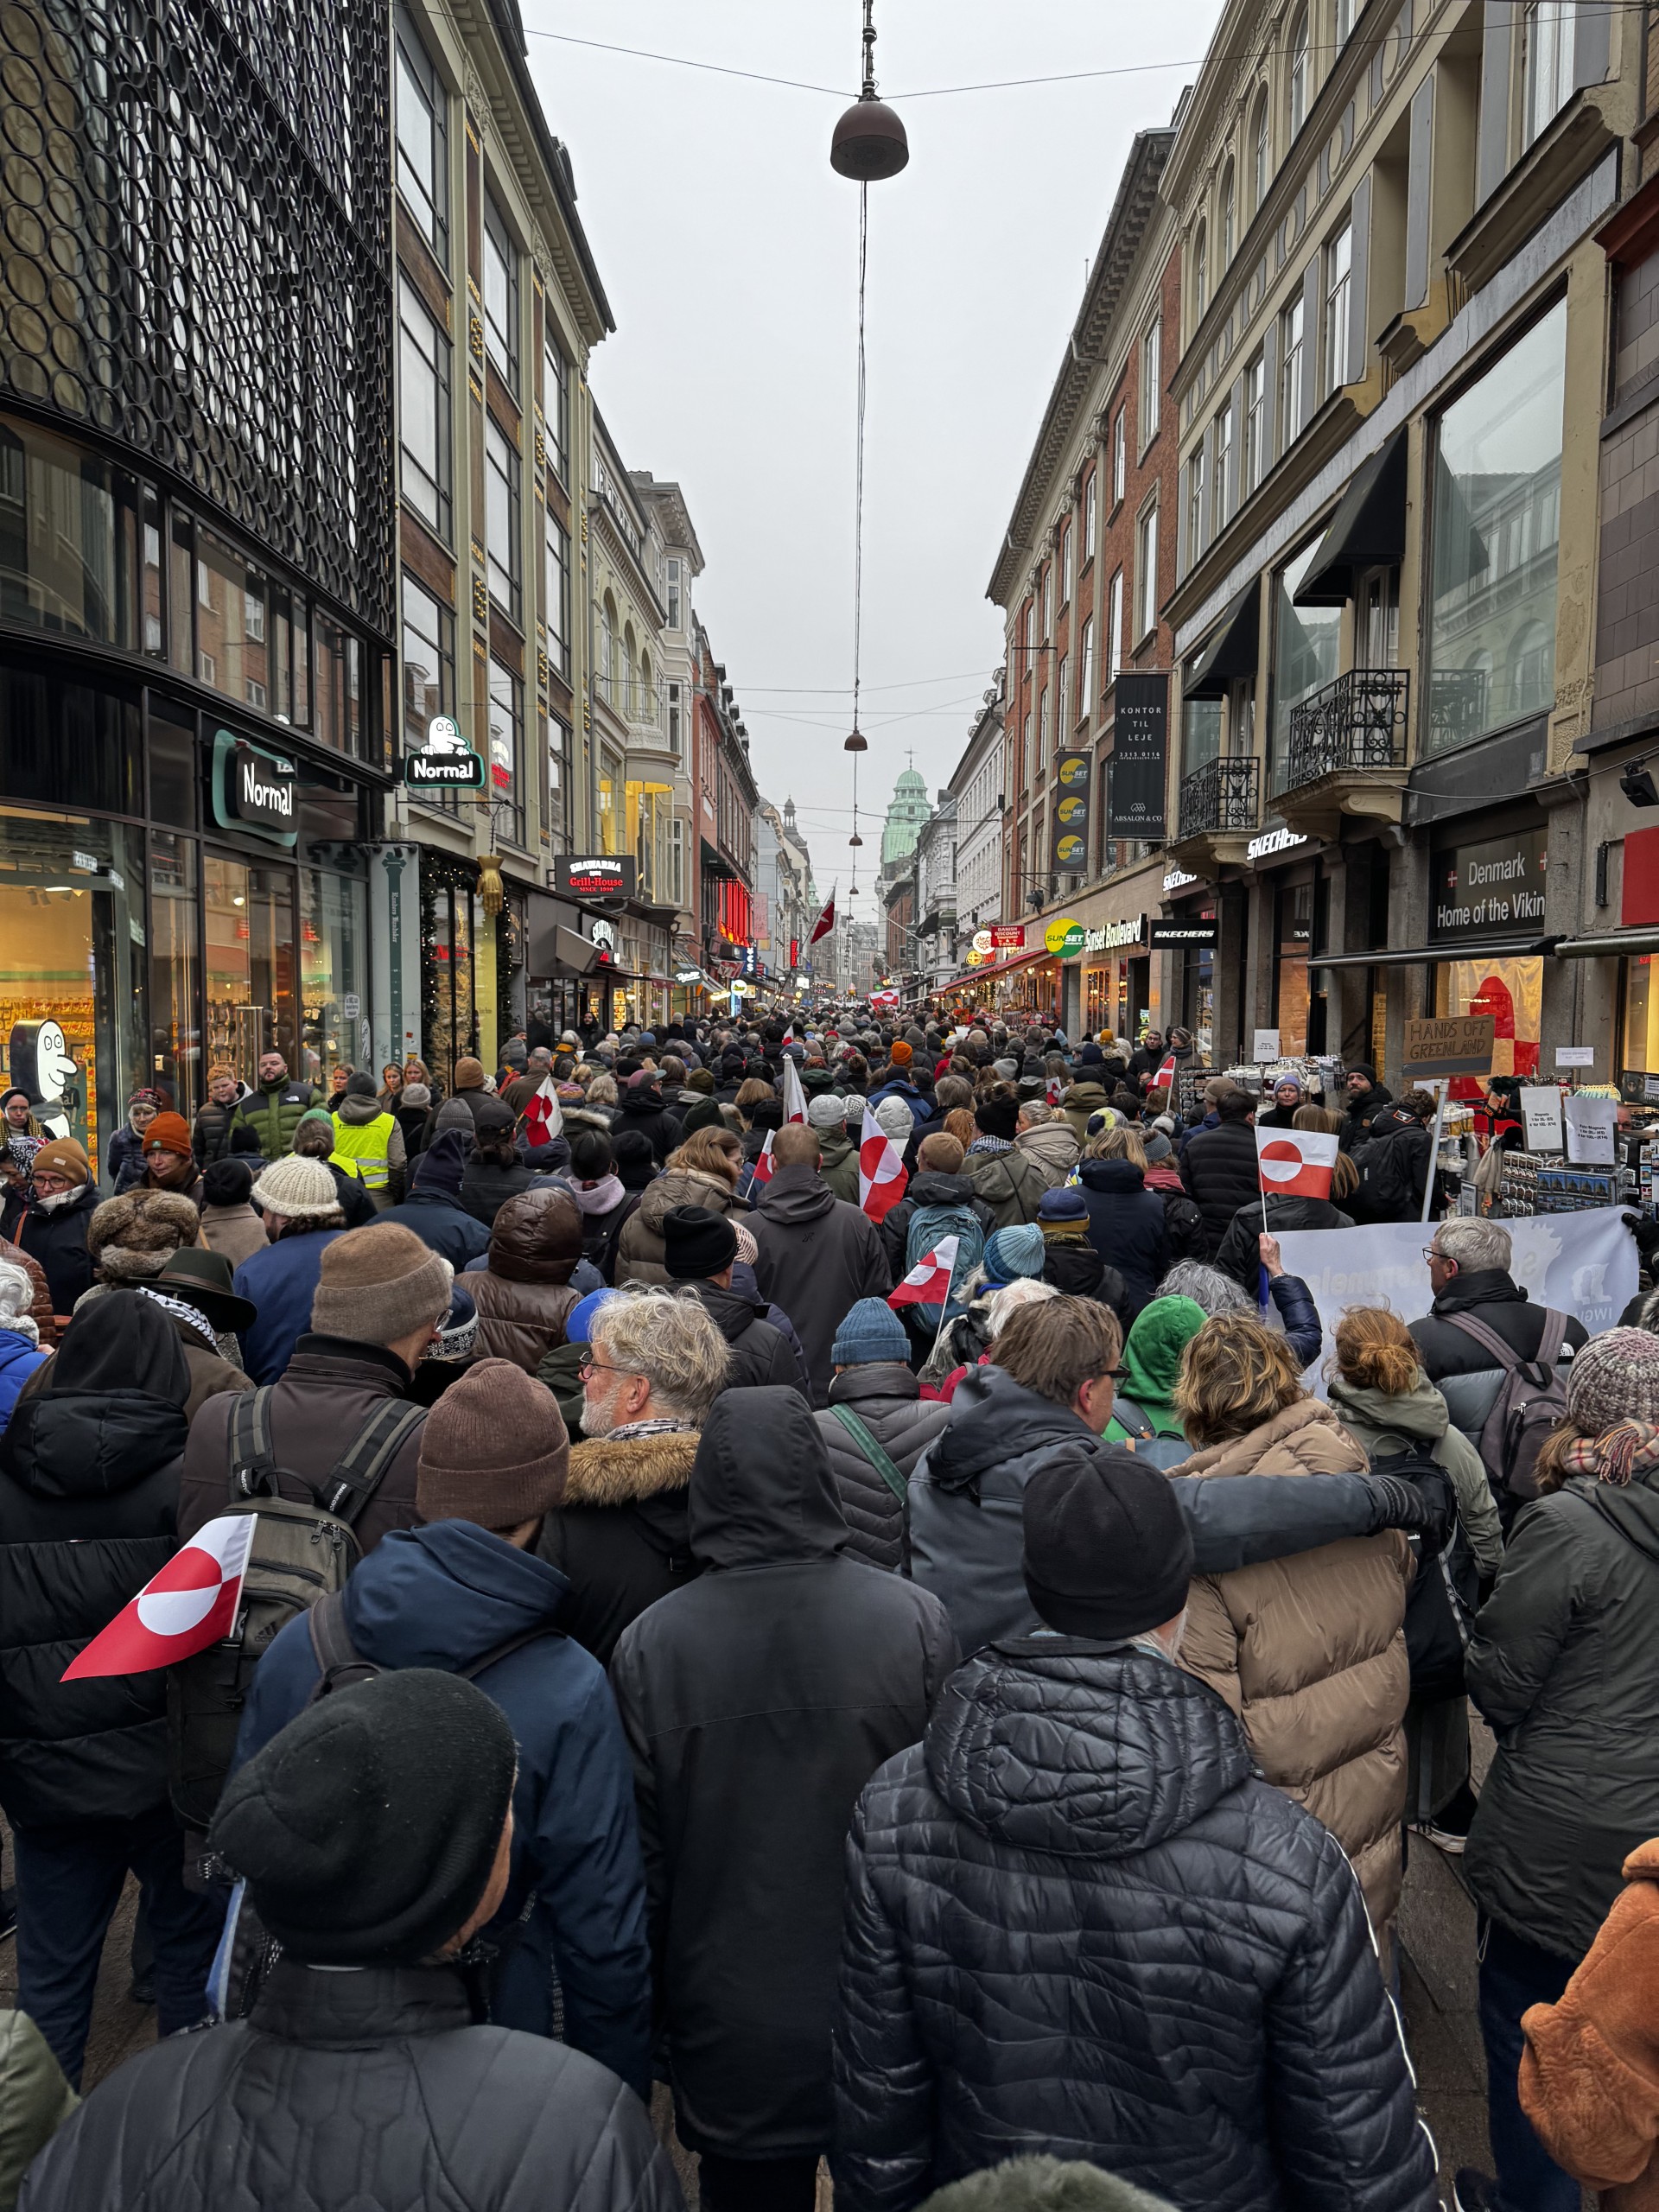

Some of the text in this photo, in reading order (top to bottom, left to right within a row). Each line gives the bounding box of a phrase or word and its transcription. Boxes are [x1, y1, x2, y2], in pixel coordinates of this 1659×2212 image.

[414, 758, 474, 779] Normal
[244, 762, 293, 817] Normal
[1468, 851, 1526, 886] Denmark
[569, 877, 623, 887] Grill-House
[1437, 891, 1546, 928] Home of the Vikin
[1085, 912, 1142, 952] Sunset Boulevard
[1154, 930, 1216, 938] SKECHERS
[1410, 1020, 1491, 1041] HANDS OFF
[1409, 1039, 1486, 1059] GREENLAND
